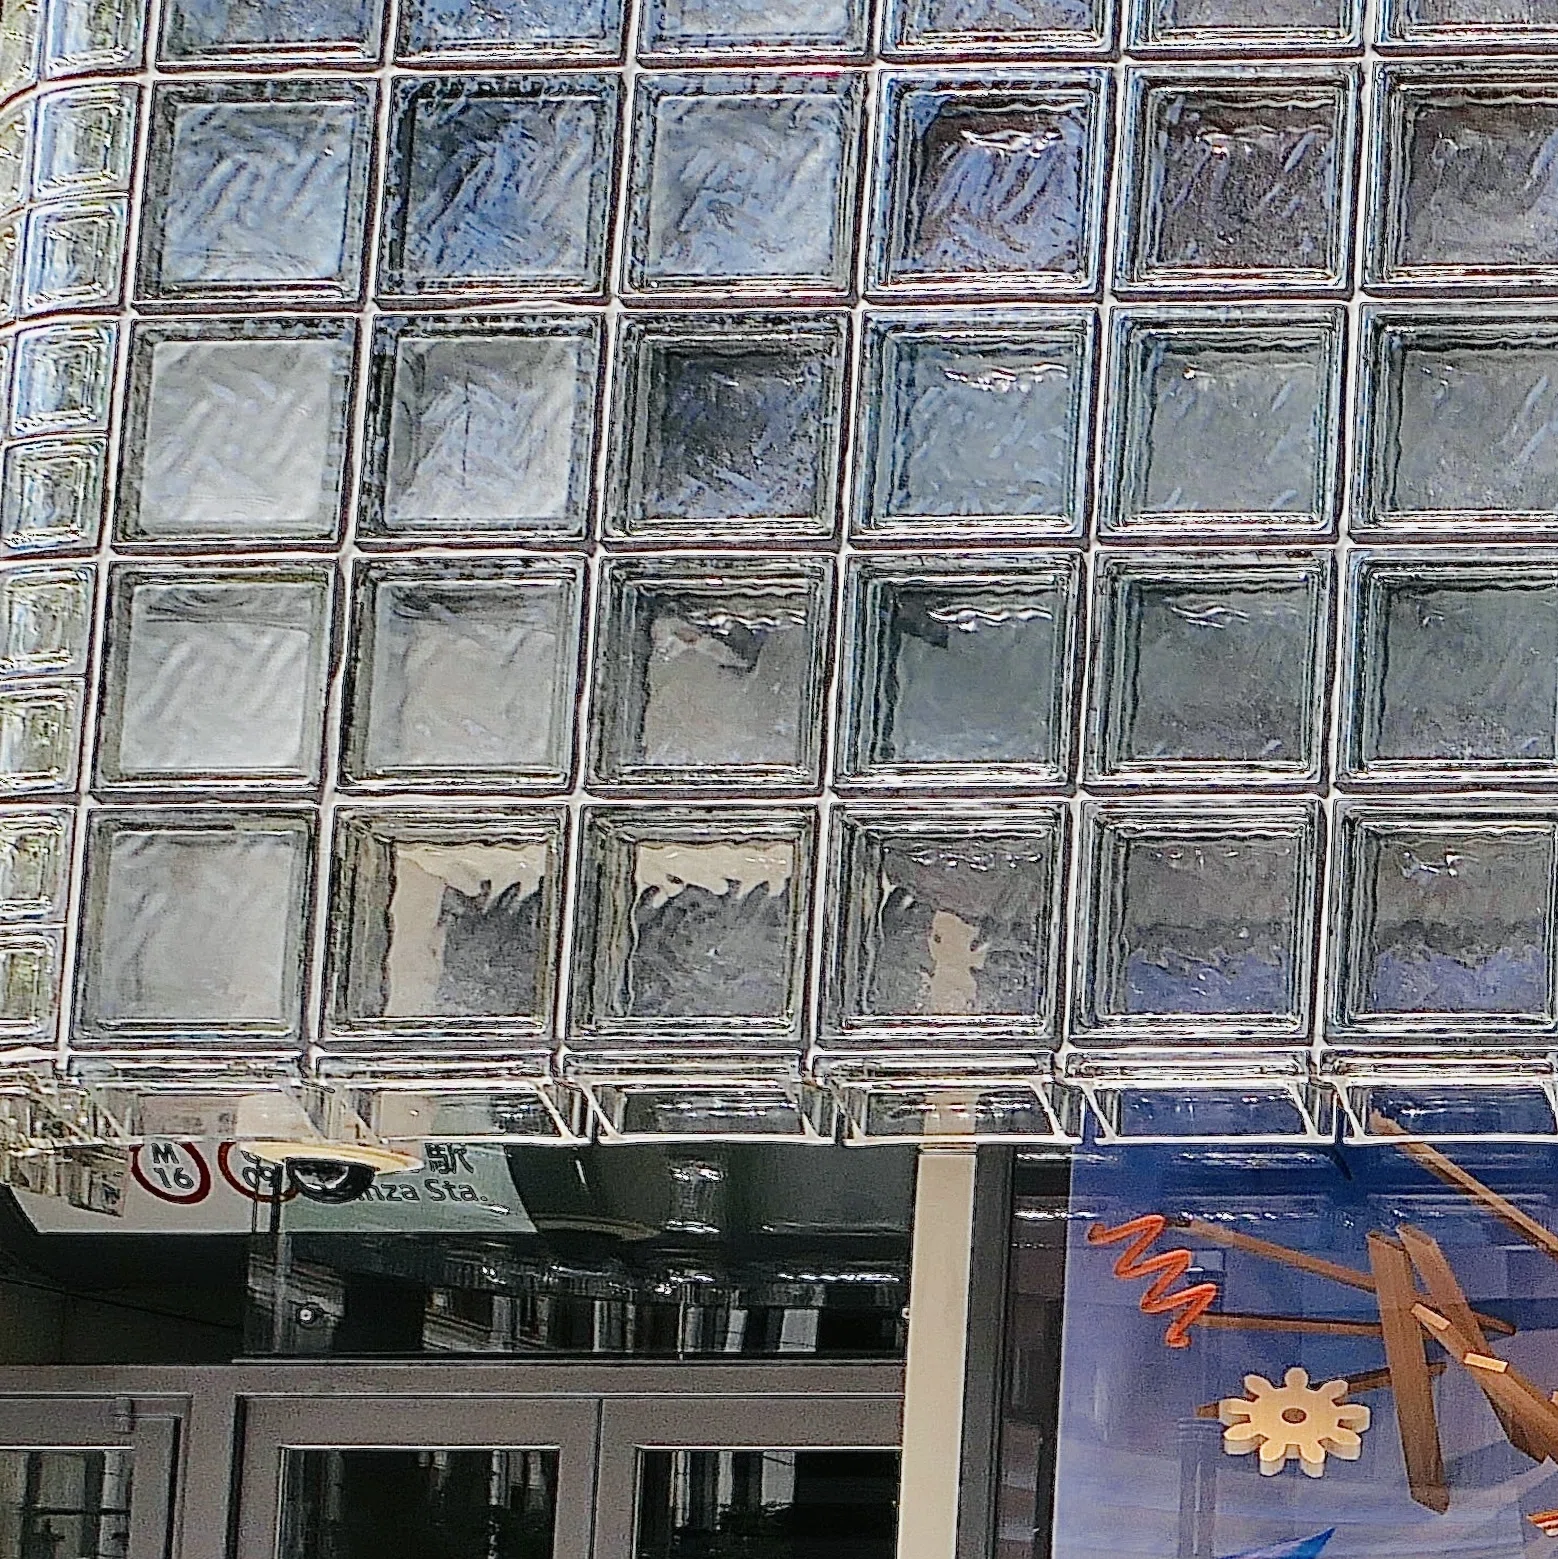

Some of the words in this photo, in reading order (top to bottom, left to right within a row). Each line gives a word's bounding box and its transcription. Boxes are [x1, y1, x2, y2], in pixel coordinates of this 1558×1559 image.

[151, 1143, 179, 1164] M
[153, 1167, 194, 1189] 16
[424, 1179, 488, 1202] Sta.
